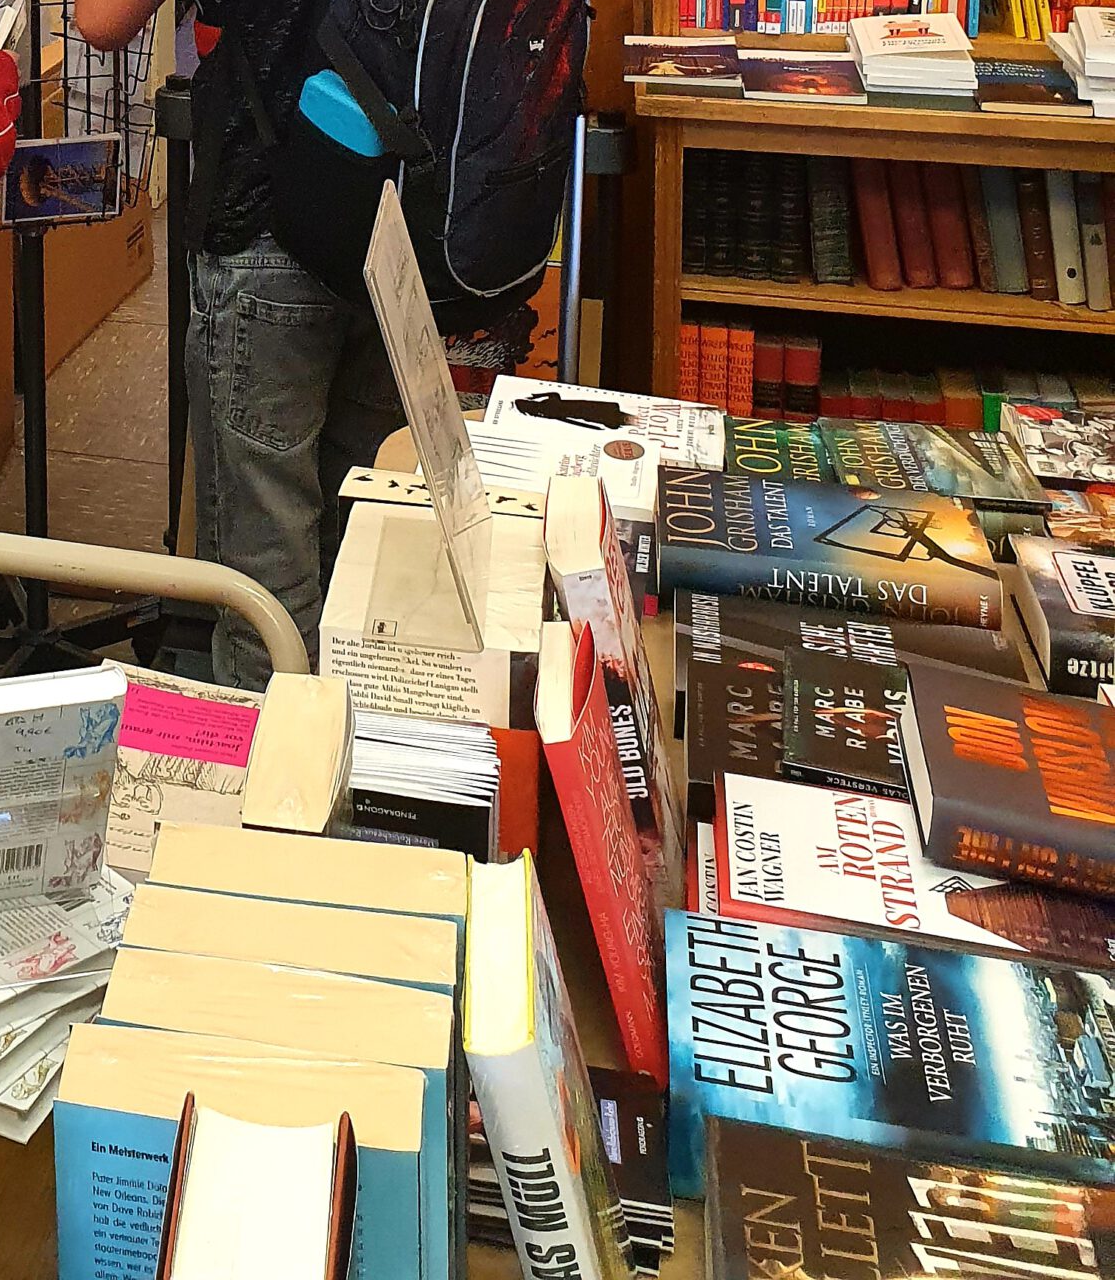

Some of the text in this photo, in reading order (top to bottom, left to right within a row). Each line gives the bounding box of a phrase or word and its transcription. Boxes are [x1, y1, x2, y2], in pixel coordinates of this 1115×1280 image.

[629, 404, 651, 436] Perfect
[733, 417, 783, 473] OHN
[836, 436, 873, 472] JOHN
[856, 422, 906, 490] GRISHAM
[556, 453, 571, 477] Katrine
[911, 473, 928, 492] DER
[665, 467, 729, 551] JOHN
[723, 475, 759, 553] GRISHAM
[763, 479, 794, 550] DAS TALENT
[767, 568, 928, 606] DAS TALENT
[1071, 559, 1115, 611] KLÜPFEL
[332, 637, 345, 645] Der
[347, 639, 360, 647] alte
[361, 640, 386, 651] Jordan
[347, 650, 358, 658] ein
[360, 652, 401, 663] ungeheures
[422, 659, 431, 667] So
[433, 661, 463, 672] wundert
[331, 659, 366, 669] eigentlich
[410, 667, 426, 677] dass
[436, 672, 454, 680] eines
[456, 674, 476, 684] Tages
[331, 668, 370, 679] erschossen
[391, 675, 429, 687] Polizeichef
[430, 681, 460, 692] Lanigan
[364, 683, 380, 692] gute
[381, 684, 402, 693] Alibis
[403, 686, 445, 700] Mangelware
[370, 692, 470, 714] David Small versagt kläglich
[725, 684, 758, 761] MARC
[814, 686, 836, 739] MARC
[843, 686, 868, 750] RAABE
[608, 704, 641, 762] BONES
[827, 775, 879, 794] VERSTECK
[364, 804, 417, 820] PENDRAGON
[732, 800, 764, 902] JAN COSTIN
[832, 792, 878, 881] ROTEN
[761, 831, 785, 902] WAGNER
[816, 845, 840, 875] AM
[874, 819, 922, 930] STRAND
[686, 915, 774, 1095] ELIZABETH
[767, 943, 858, 1085] GEORGE
[880, 991, 912, 1061] WAS IM
[903, 962, 953, 1104] VERBORGENEN
[942, 1008, 978, 1066] RUHT
[91, 1141, 170, 1164] Ein Meisterwerk
[92, 1171, 145, 1189] Pater Jimmie
[92, 1185, 149, 1204] New Orleans.
[501, 1147, 569, 1233] MÜLL
[93, 1201, 134, 1216] von Dave
[93, 1214, 127, 1229] holt die
[93, 1229, 149, 1246] ein vertrauter
[126, 1262, 142, 1272] wer
